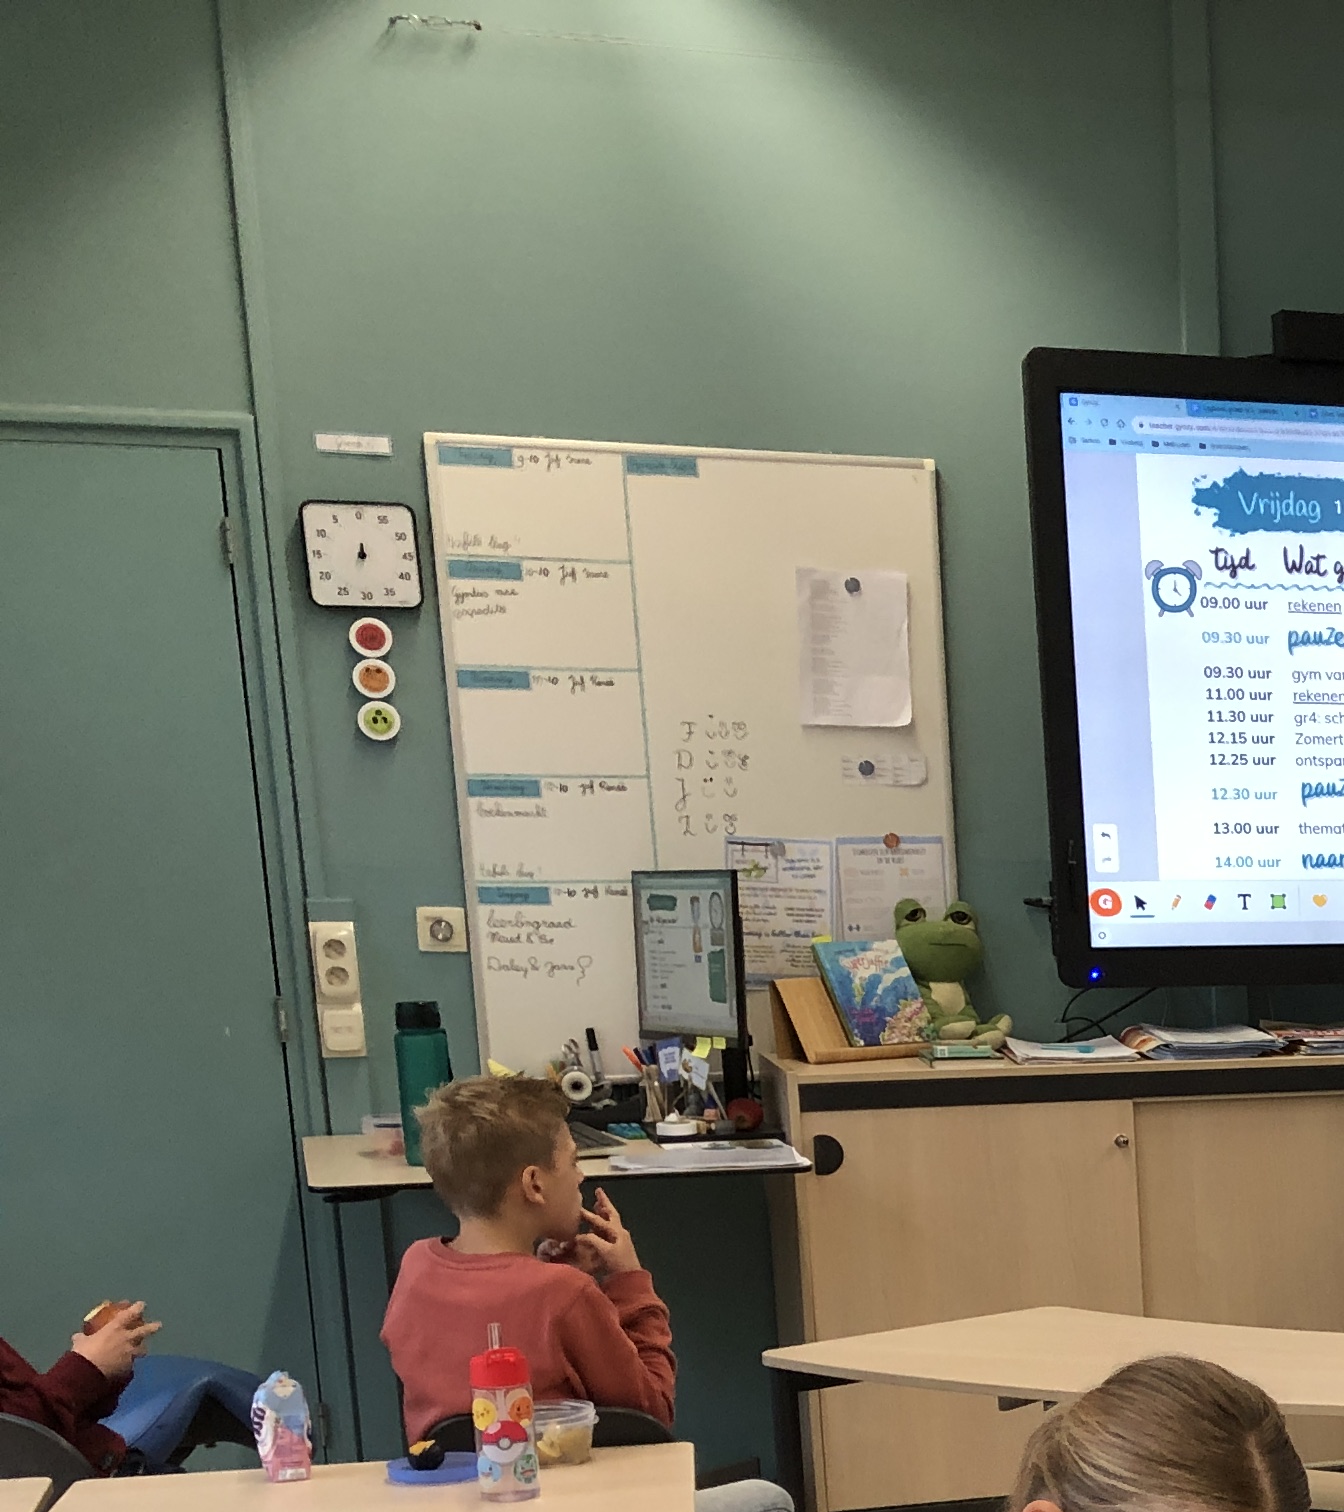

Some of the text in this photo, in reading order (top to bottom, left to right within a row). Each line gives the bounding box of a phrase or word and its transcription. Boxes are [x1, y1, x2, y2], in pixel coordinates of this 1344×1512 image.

[1237, 491, 1321, 523] Vrijdag
[332, 515, 338, 523] 5
[355, 511, 362, 520] 0
[377, 516, 389, 524] 55
[316, 529, 326, 538] 10
[395, 532, 407, 541] 50
[312, 550, 322, 559] 15
[402, 552, 414, 561] 45
[1283, 544, 1328, 576] Wat
[319, 572, 331, 580] 20
[399, 572, 411, 581] 40
[337, 587, 349, 595] 25
[361, 592, 373, 600] 30
[384, 588, 395, 596] 35
[1200, 597, 1268, 610] 09.00 uur
[1288, 599, 1341, 614] rekenen
[1202, 632, 1270, 644] 09.30 uur
[1203, 666, 1272, 679] 09.30 uur
[1292, 669, 1322, 683] gym
[1205, 688, 1273, 701] 11.00 uur
[1208, 710, 1274, 723] 11.30 uur
[1294, 713, 1321, 725] gr4:
[1208, 732, 1275, 744] 12.15 uur
[1209, 754, 1276, 766] 12.25 uur
[1211, 788, 1278, 800] 12.30 uur
[1213, 823, 1279, 835] 13.00 uur
[1215, 856, 1281, 868] 14.00 uur
